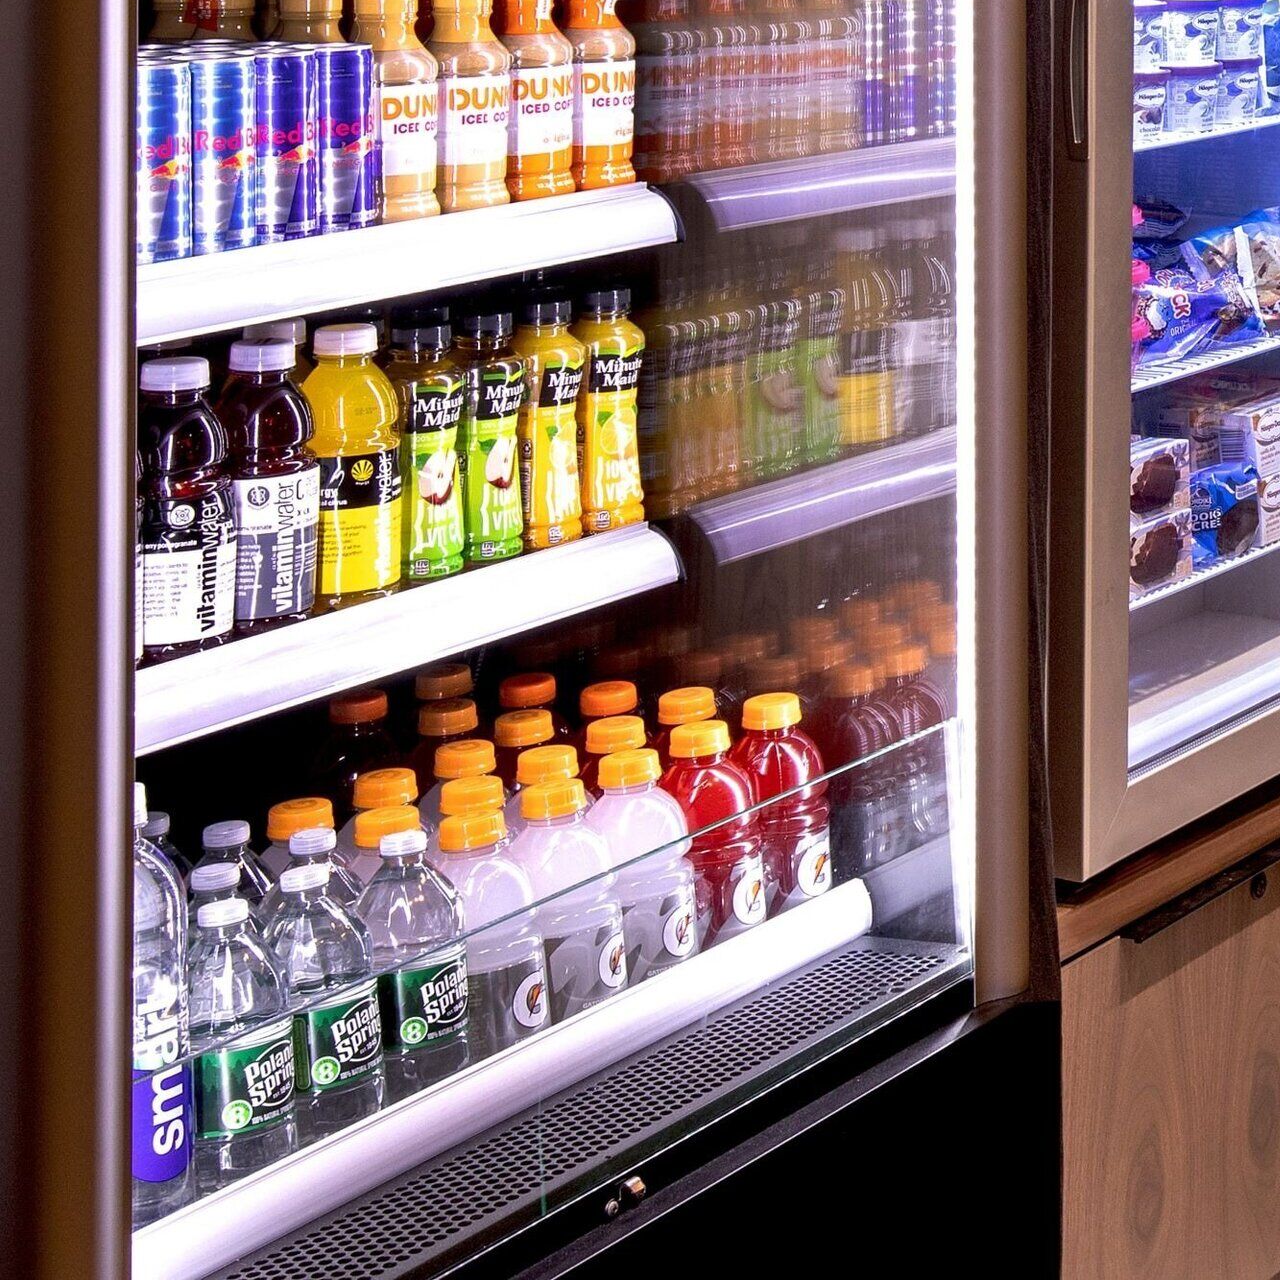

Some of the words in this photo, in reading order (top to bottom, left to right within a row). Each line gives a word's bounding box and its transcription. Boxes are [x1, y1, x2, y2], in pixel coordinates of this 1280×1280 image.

[521, 103, 550, 115] ICED
[592, 95, 619, 108] ICED
[194, 128, 241, 153] Red
[603, 370, 637, 387] Maid
[407, 1023, 421, 1044] 8
[319, 1061, 335, 1083] 8
